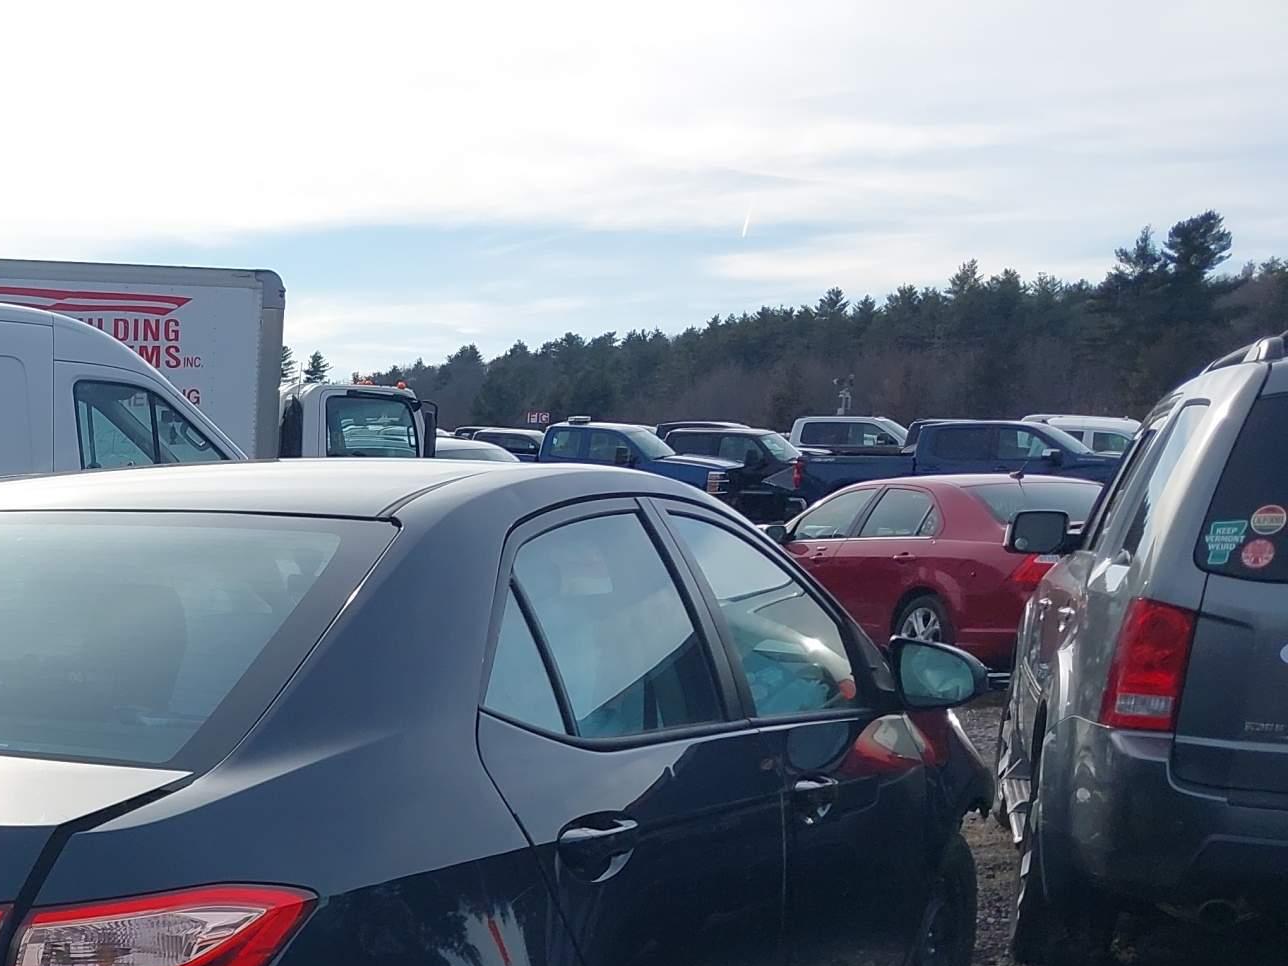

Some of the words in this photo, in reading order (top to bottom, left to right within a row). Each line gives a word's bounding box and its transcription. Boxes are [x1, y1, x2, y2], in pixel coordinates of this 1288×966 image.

[183, 355, 204, 368] INC.
[1216, 527, 1238, 535] KEEP
[1205, 535, 1245, 543] VERMONT
[1208, 543, 1236, 551] WEIRD
